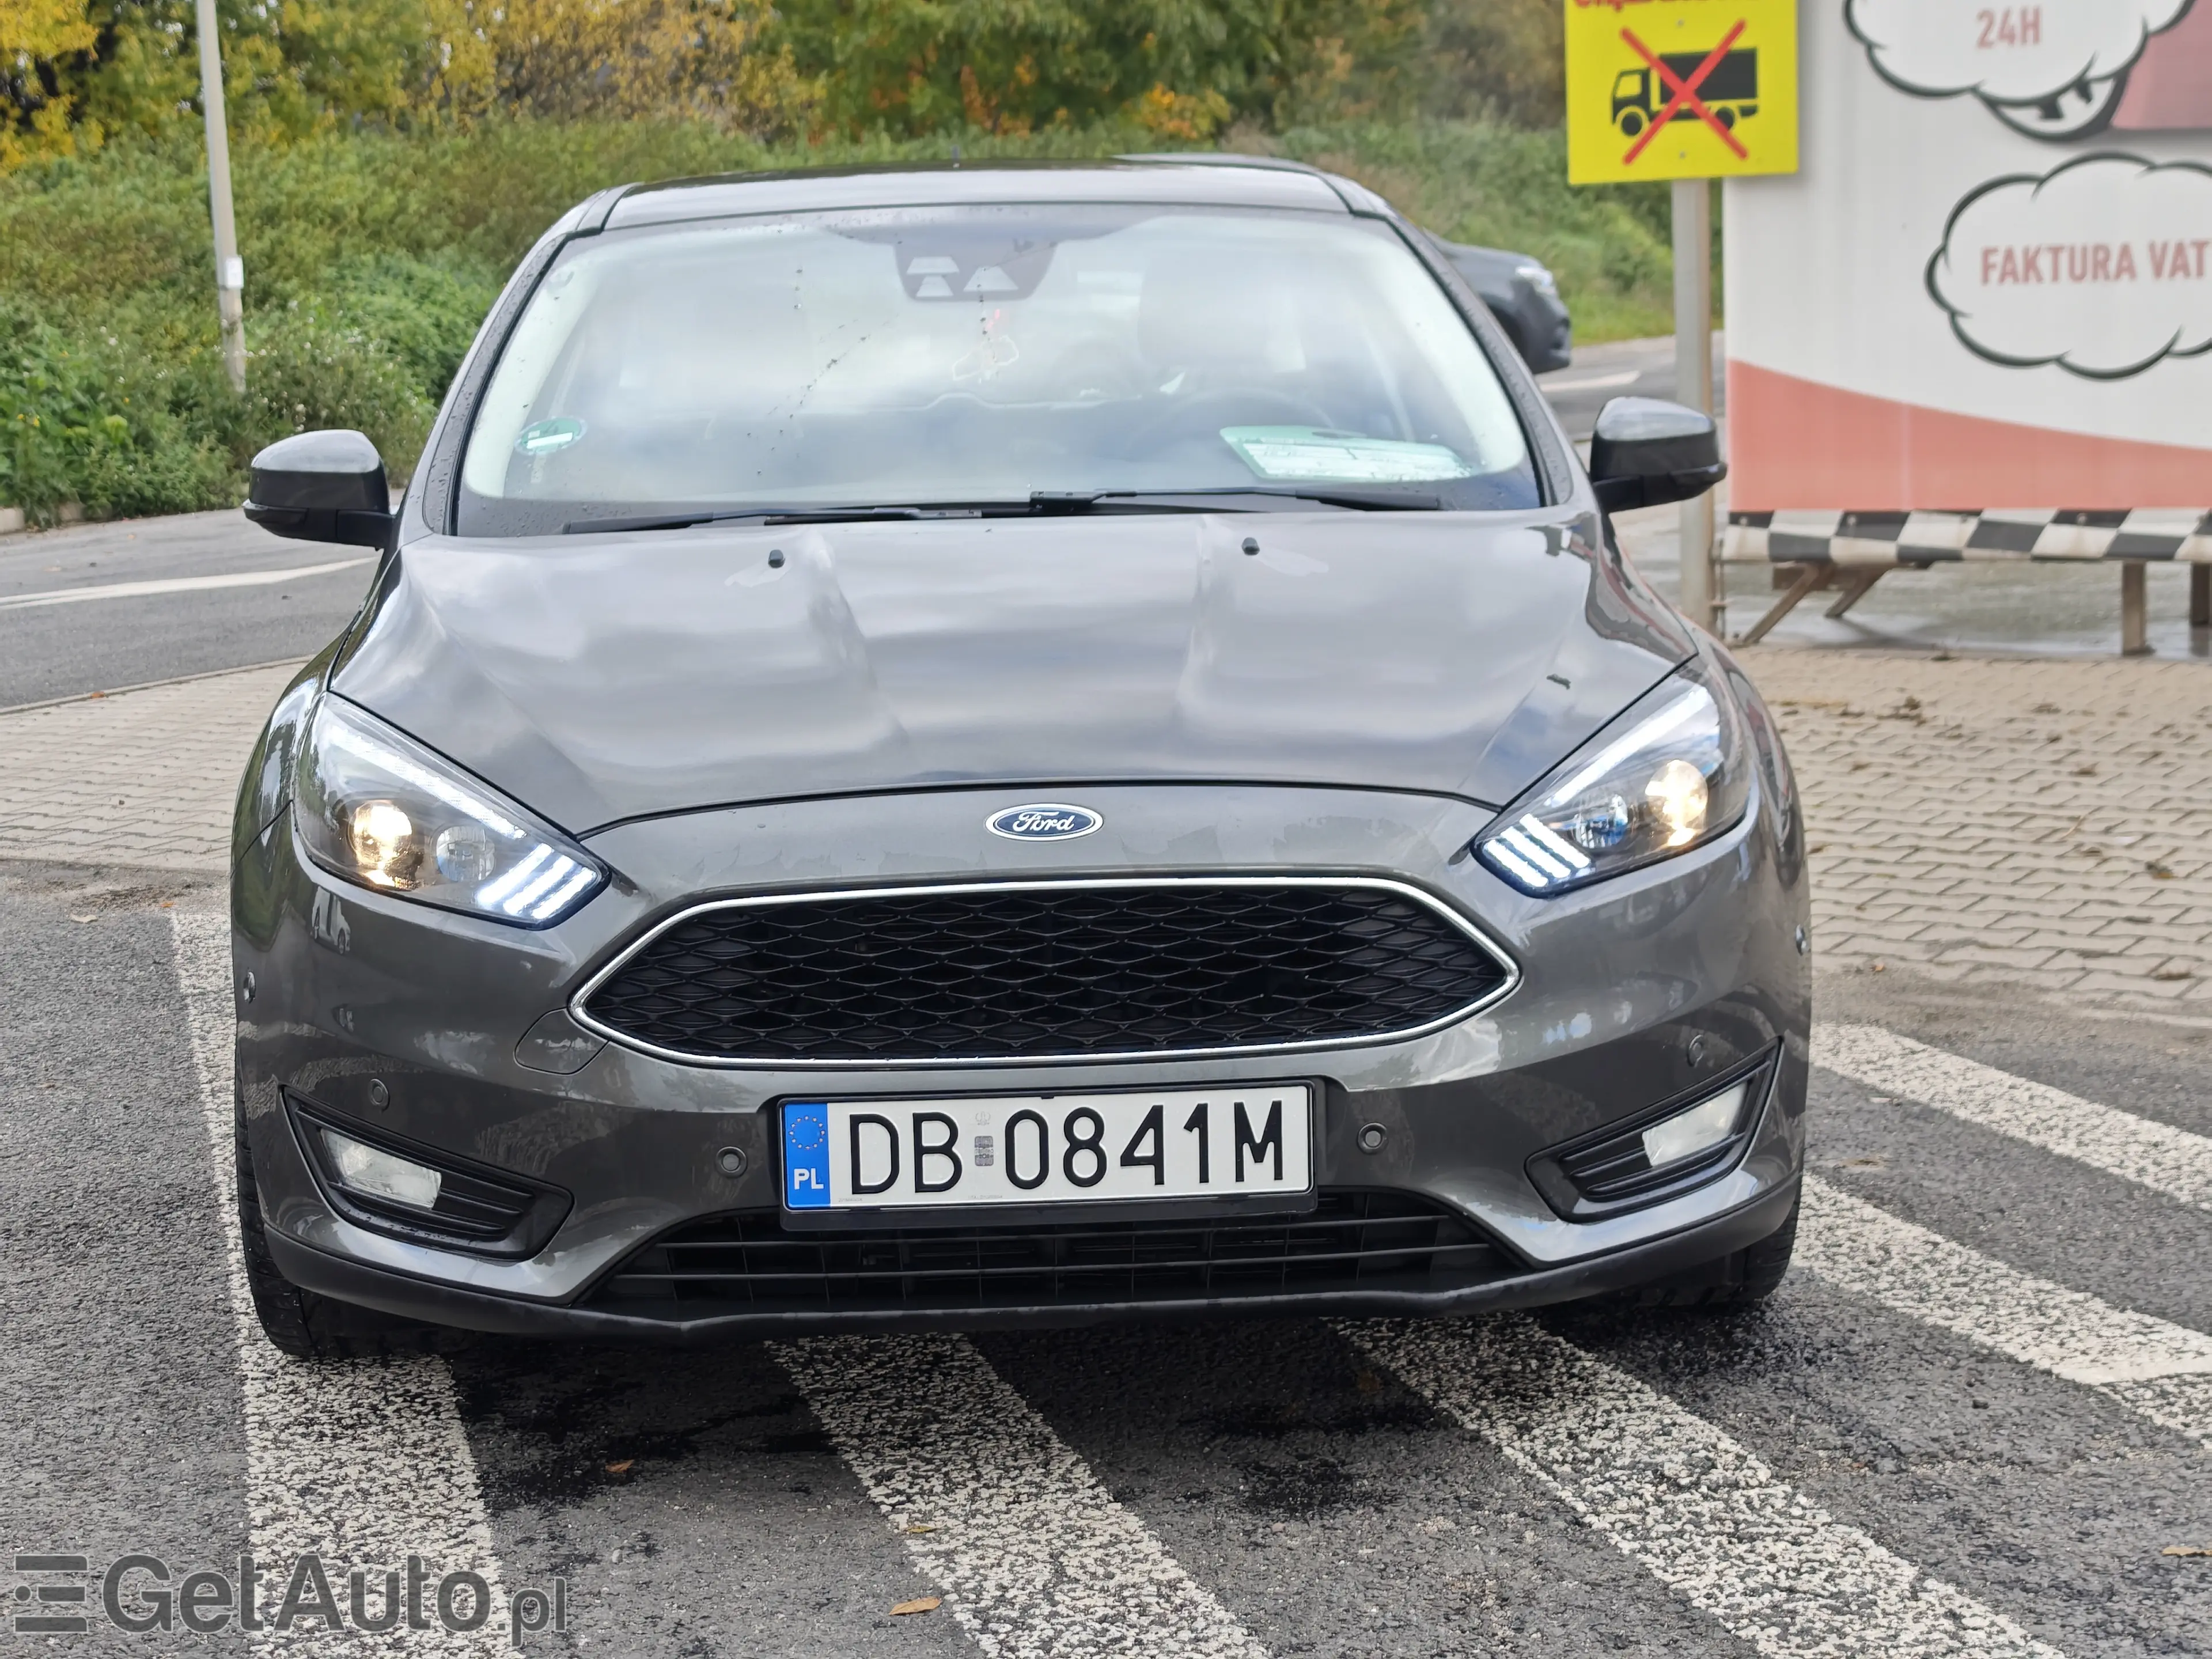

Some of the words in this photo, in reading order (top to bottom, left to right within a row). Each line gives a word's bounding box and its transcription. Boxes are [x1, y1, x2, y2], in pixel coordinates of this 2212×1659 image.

[1975, 6, 2042, 49] 24H
[1980, 242, 2137, 286] FAKTURA
[2148, 239, 2210, 280] VAT
[1012, 811, 1075, 832] Ford
[849, 1111, 963, 1195] DB
[1004, 1099, 1284, 1190] 0841M
[794, 1168, 824, 1190] PL
